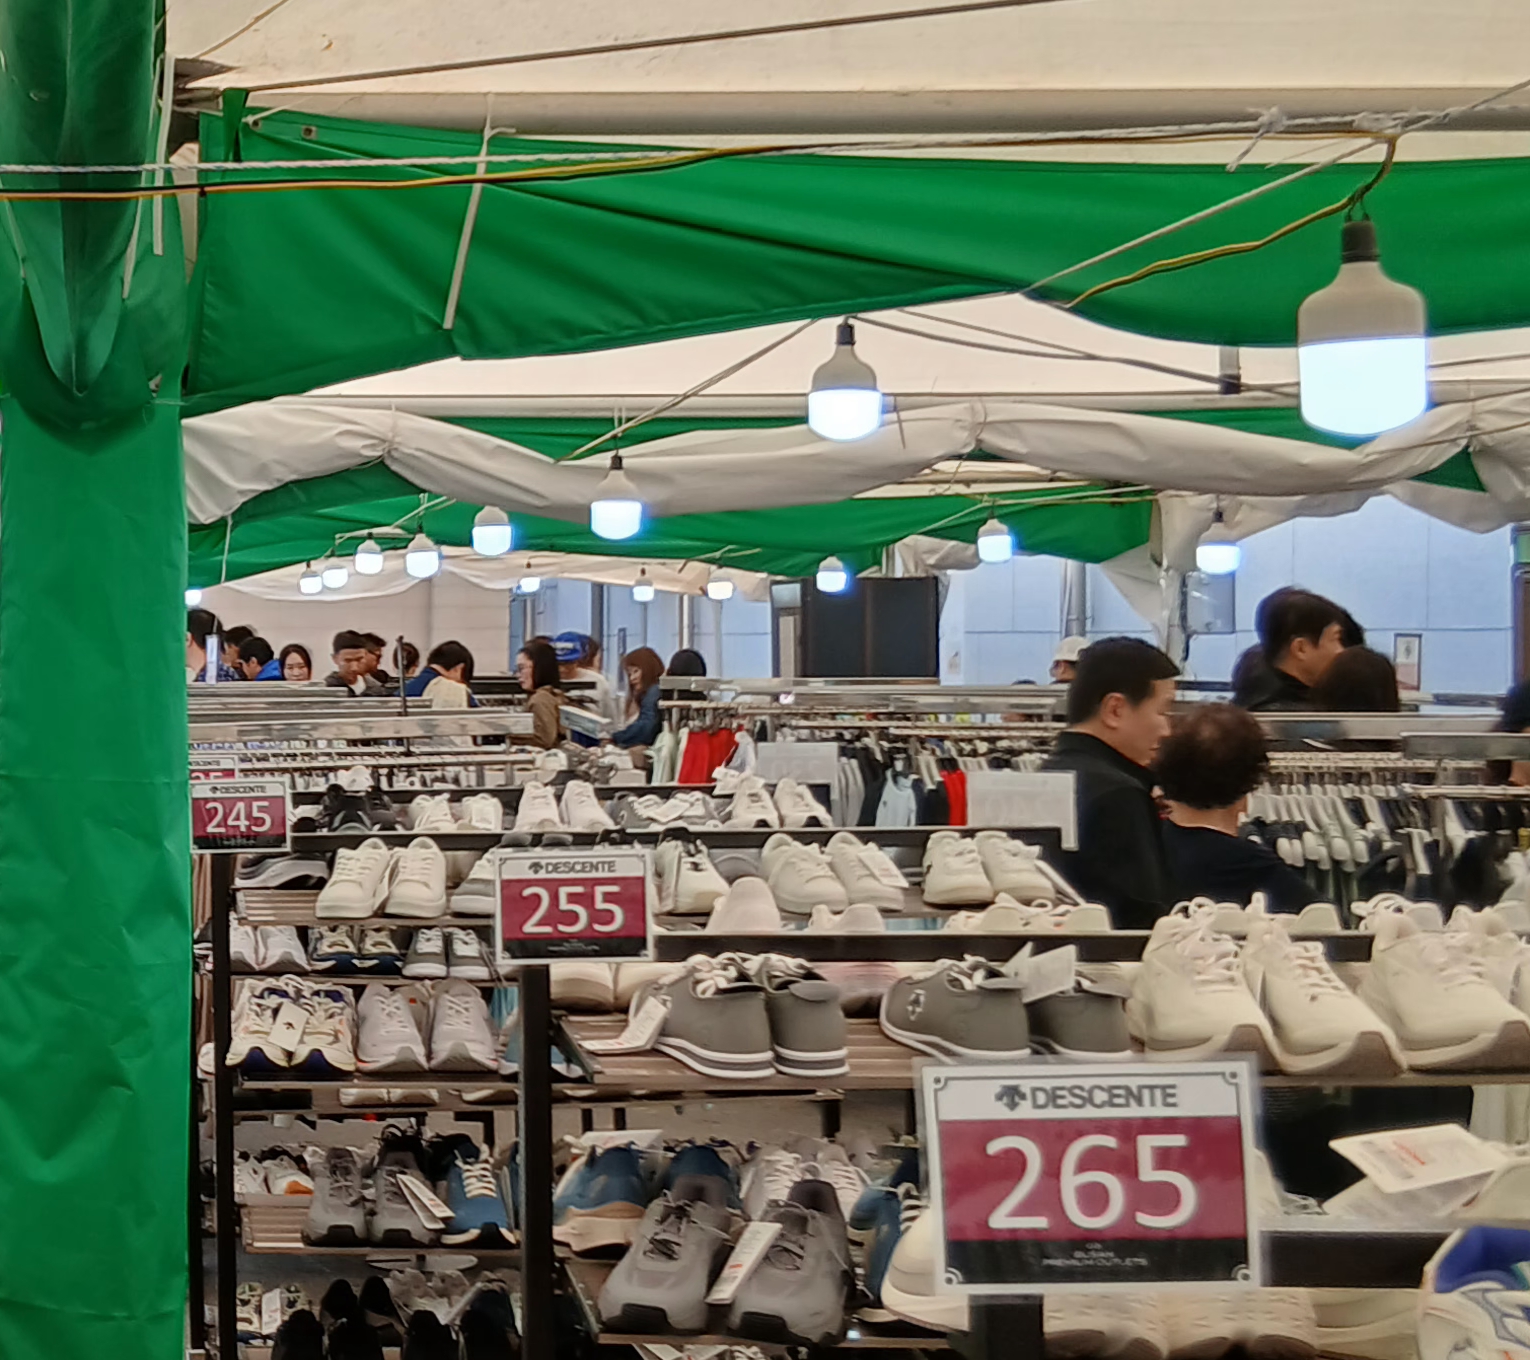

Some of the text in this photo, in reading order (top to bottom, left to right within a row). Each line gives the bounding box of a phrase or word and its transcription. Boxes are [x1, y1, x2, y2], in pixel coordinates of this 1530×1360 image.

[219, 785, 267, 794] DESCENTE
[205, 801, 271, 833] 245
[545, 860, 617, 874] DESCENTE
[522, 885, 625, 934] 255
[1031, 1084, 1178, 1110] DESCENTE
[985, 1134, 1199, 1230] 265
